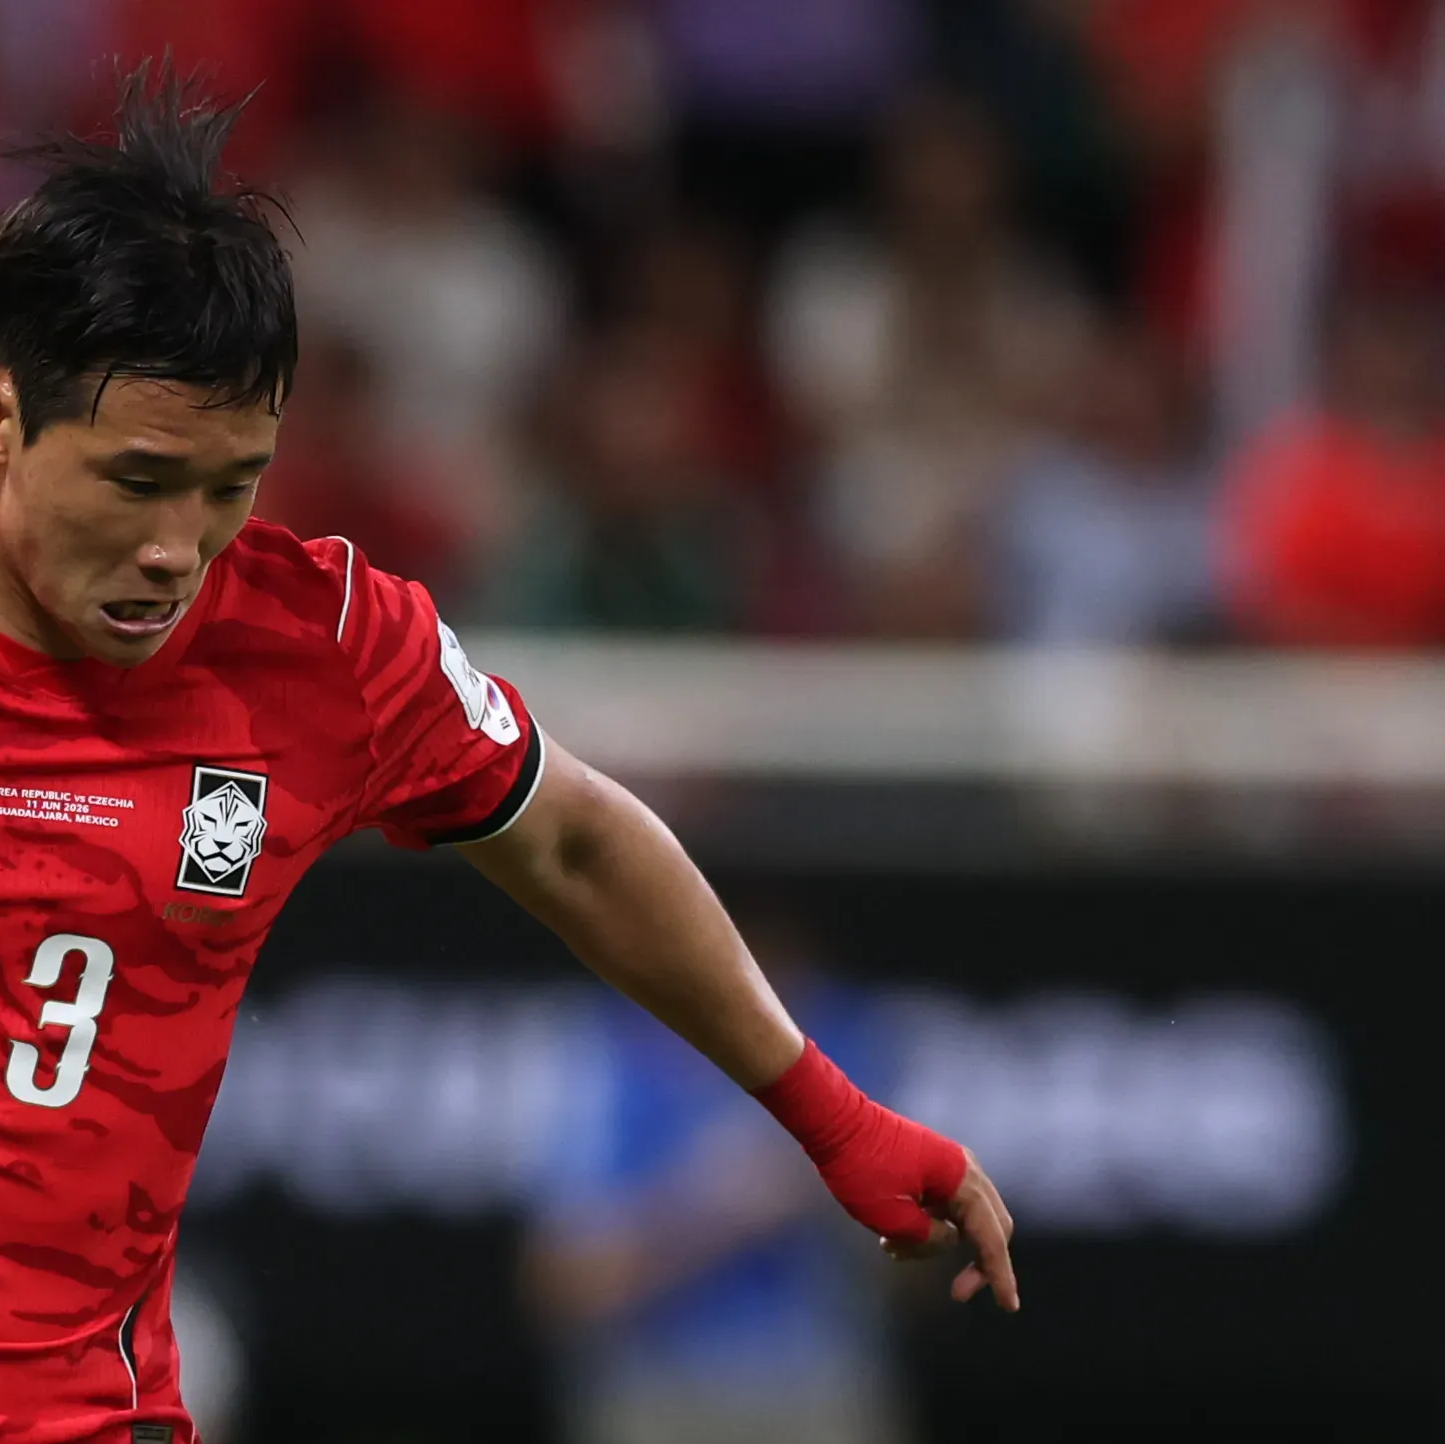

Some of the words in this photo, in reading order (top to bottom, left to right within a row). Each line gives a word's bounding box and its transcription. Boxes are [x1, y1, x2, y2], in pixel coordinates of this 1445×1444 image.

[21, 789, 71, 802] REPUBLIC
[88, 796, 135, 809] CZECHIA
[26, 800, 38, 808] 11
[41, 801, 61, 811] JUN
[63, 803, 89, 814] 2026
[75, 815, 119, 827] MEXICO
